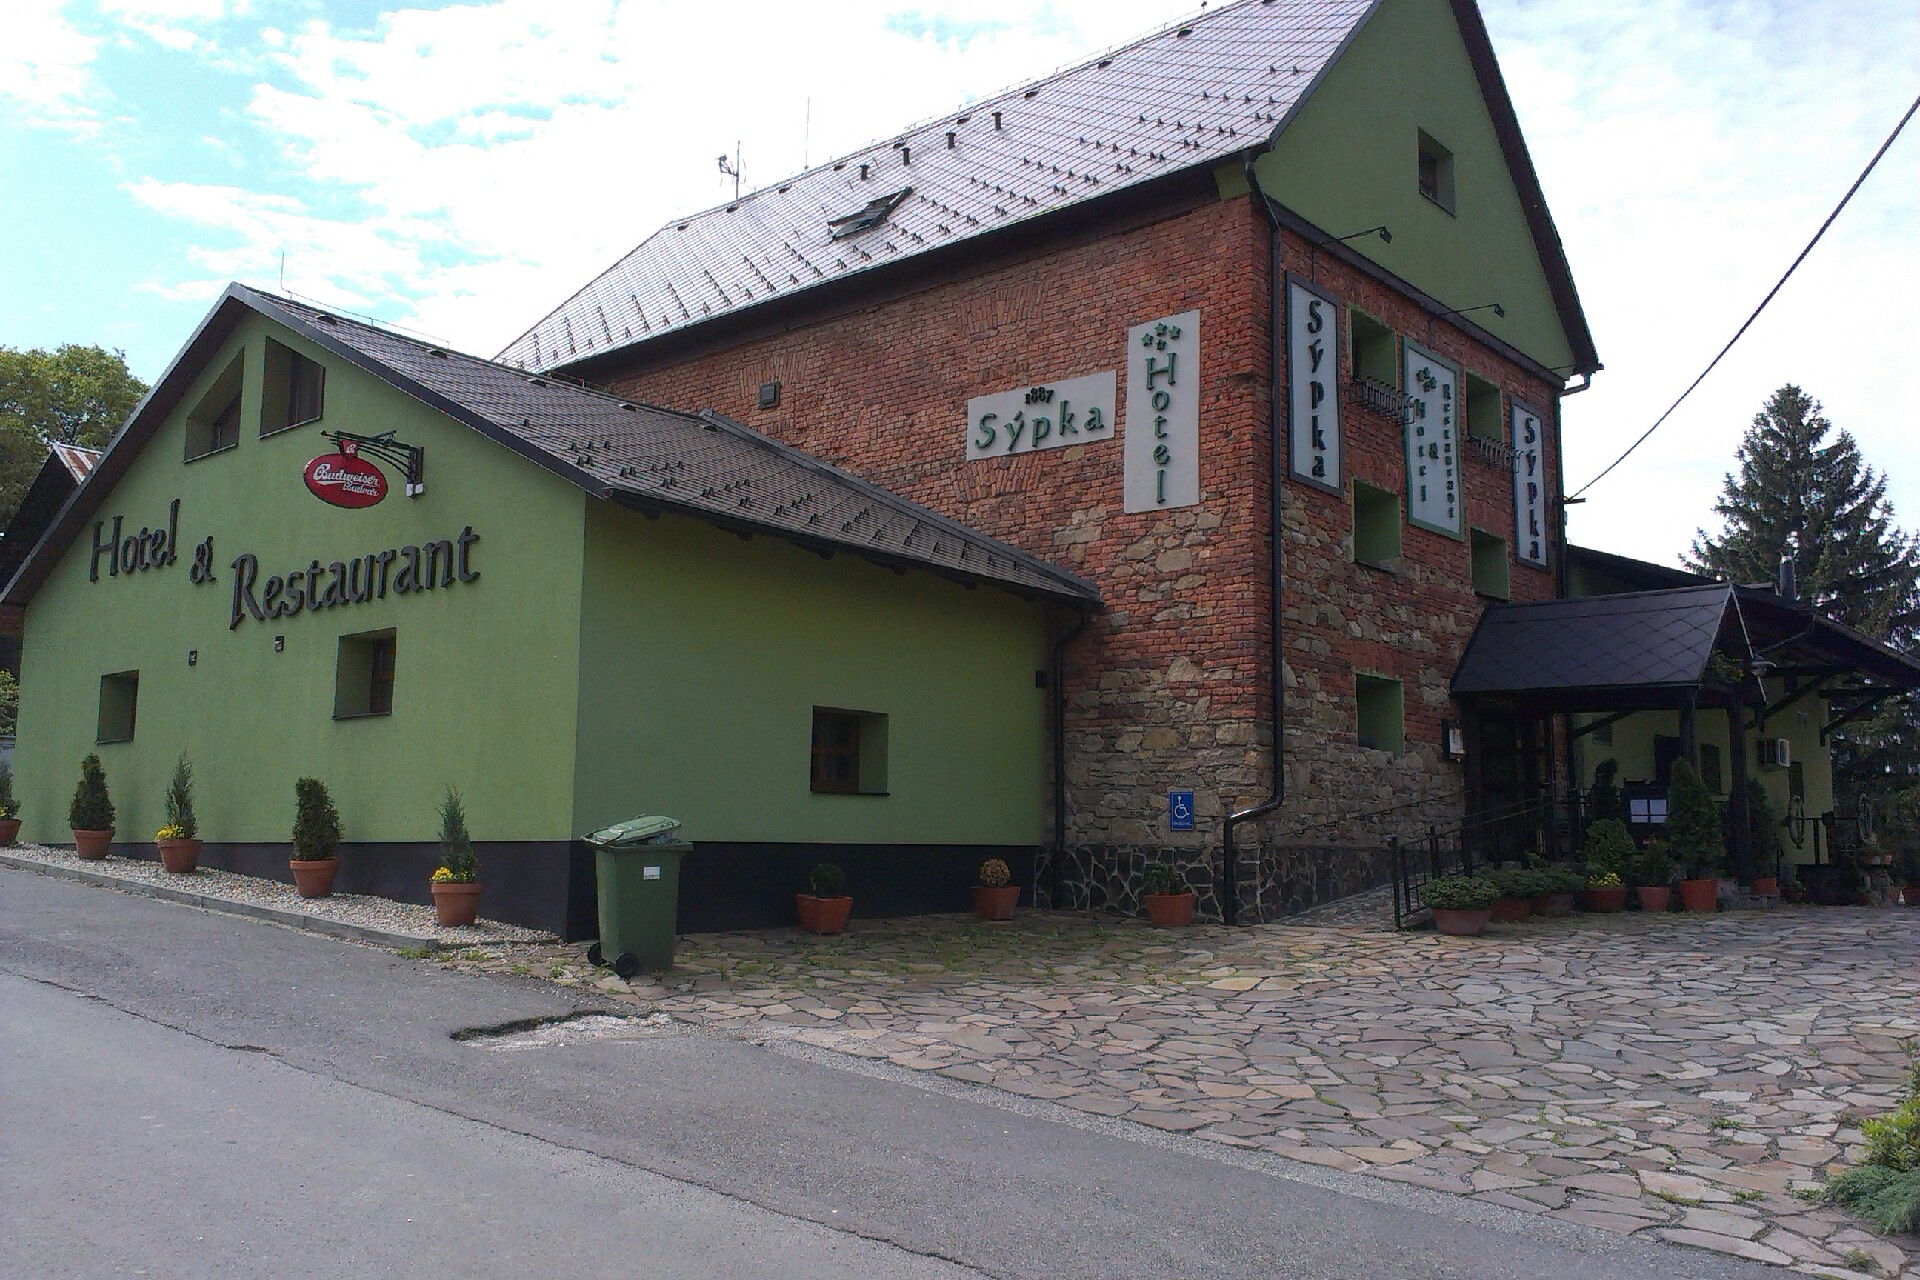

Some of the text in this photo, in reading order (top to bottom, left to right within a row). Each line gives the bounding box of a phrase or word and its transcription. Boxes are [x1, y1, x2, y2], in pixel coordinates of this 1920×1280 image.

[975, 399, 1105, 452] Sýpka
[1024, 386, 1055, 405] 1887
[1144, 352, 1178, 505] Hotel
[1307, 300, 1326, 477] Sýpka
[313, 463, 379, 487] Budweiser
[343, 481, 380, 497] Budvar
[1415, 398, 1427, 502] Hotel
[1428, 442, 1440, 460] &
[1442, 383, 1455, 519] Restaurant
[1525, 417, 1540, 559] Sýpka
[90, 499, 216, 585] Hotel &
[230, 526, 481, 631] Restaurant
